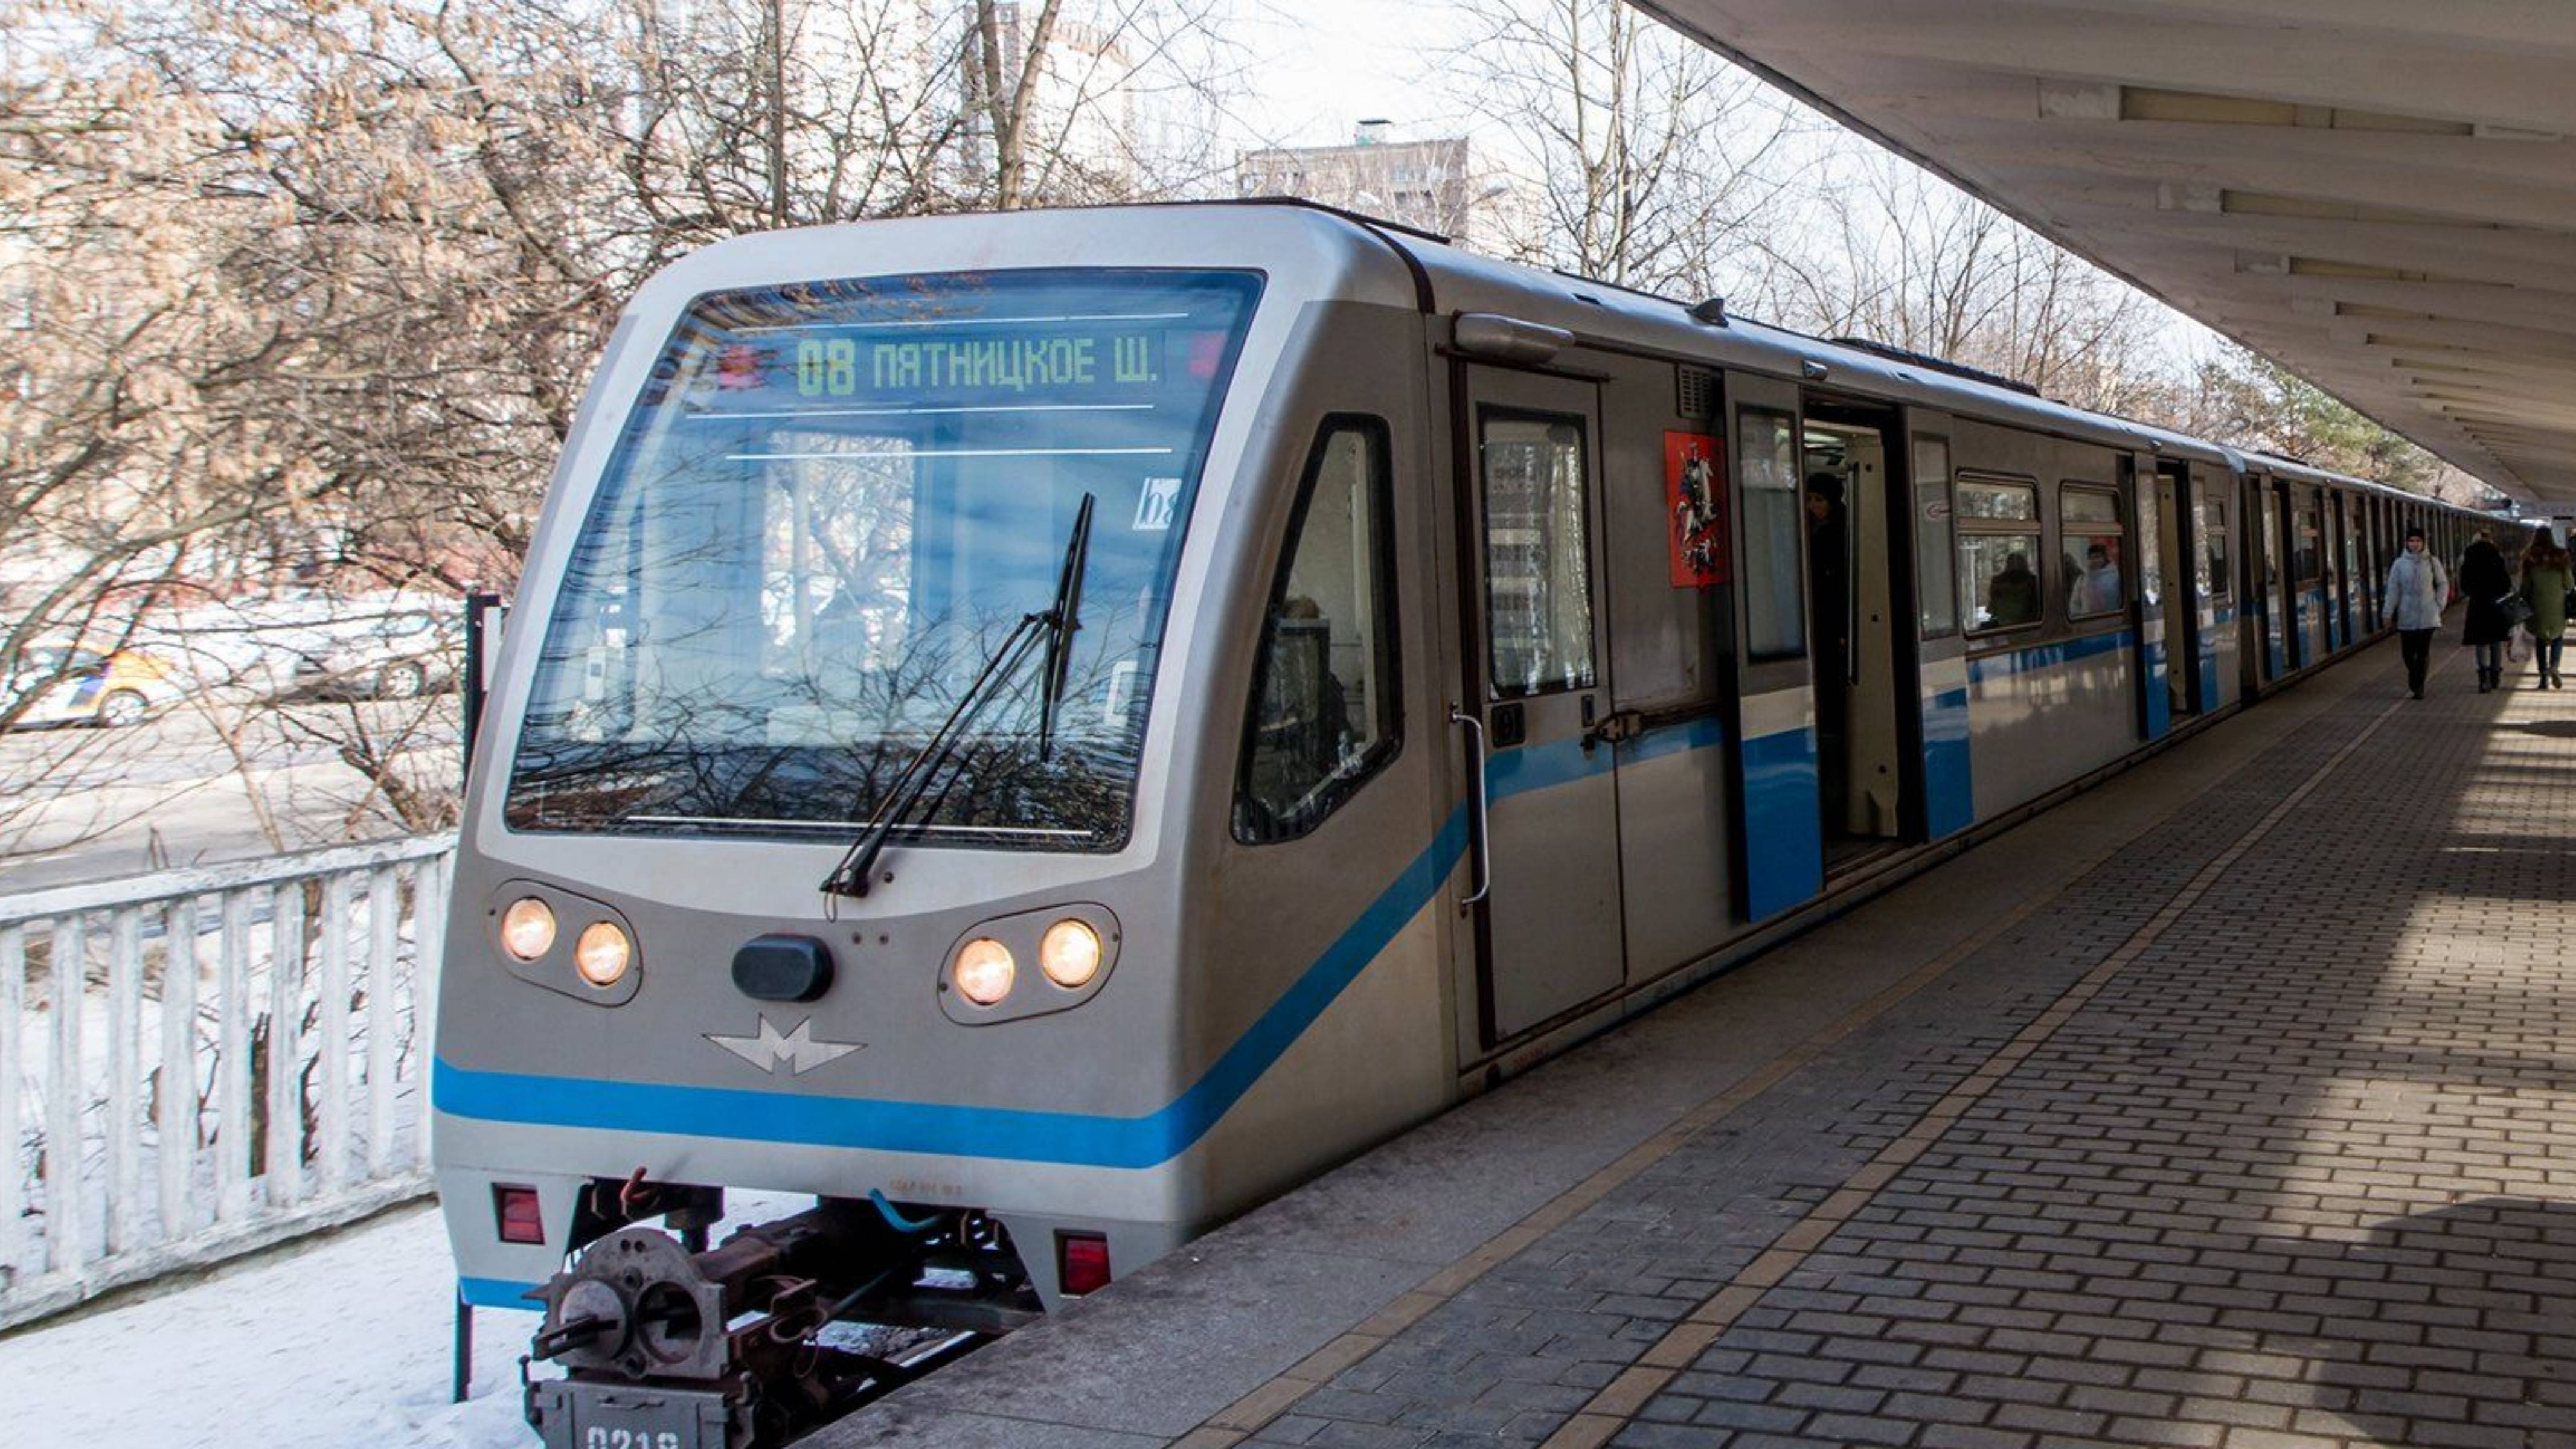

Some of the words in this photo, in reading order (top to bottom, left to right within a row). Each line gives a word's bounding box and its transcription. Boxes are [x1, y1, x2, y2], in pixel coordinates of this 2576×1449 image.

[798, 338, 856, 397] 08
[874, 338, 1095, 392] ПЯТНИЦКОЕ
[1114, 336, 1157, 383] Ш.
